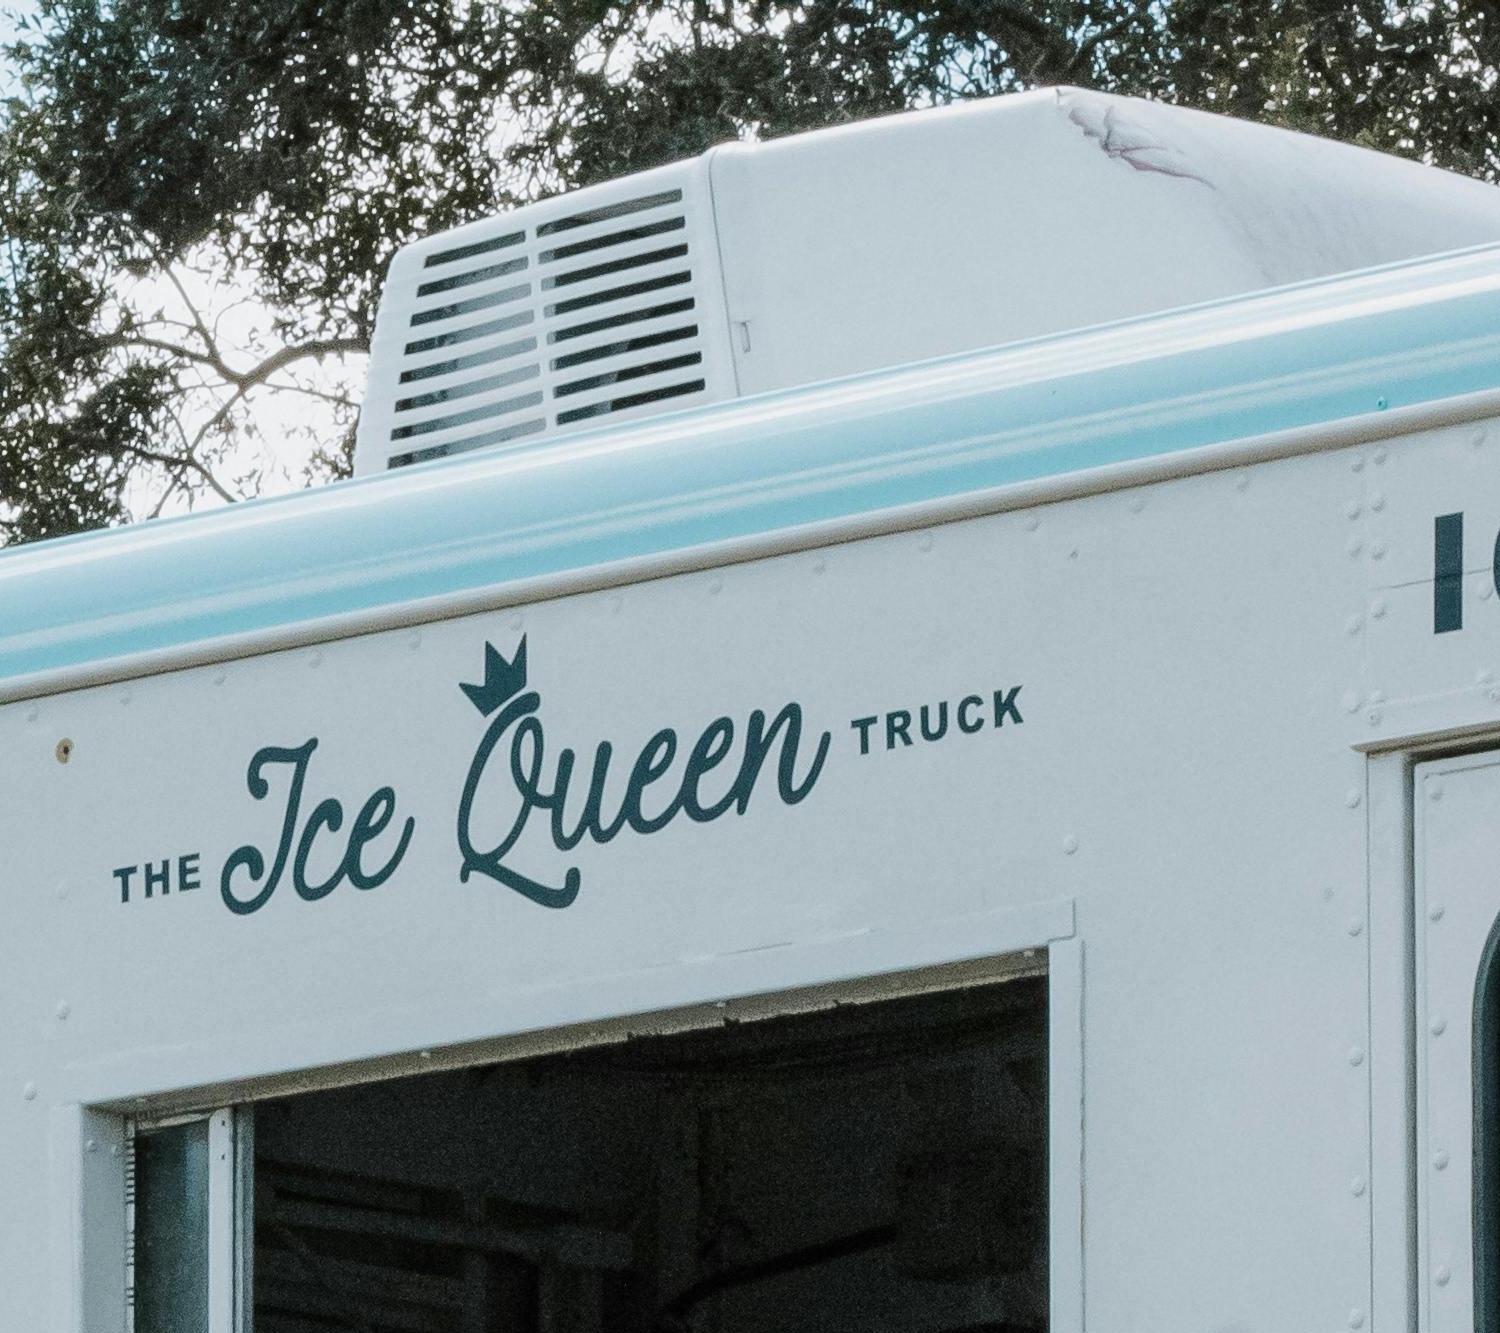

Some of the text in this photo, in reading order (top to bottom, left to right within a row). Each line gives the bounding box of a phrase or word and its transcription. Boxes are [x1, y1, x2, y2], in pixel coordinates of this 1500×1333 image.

[112, 685, 1025, 916] THE Ice Queen TRUCK
